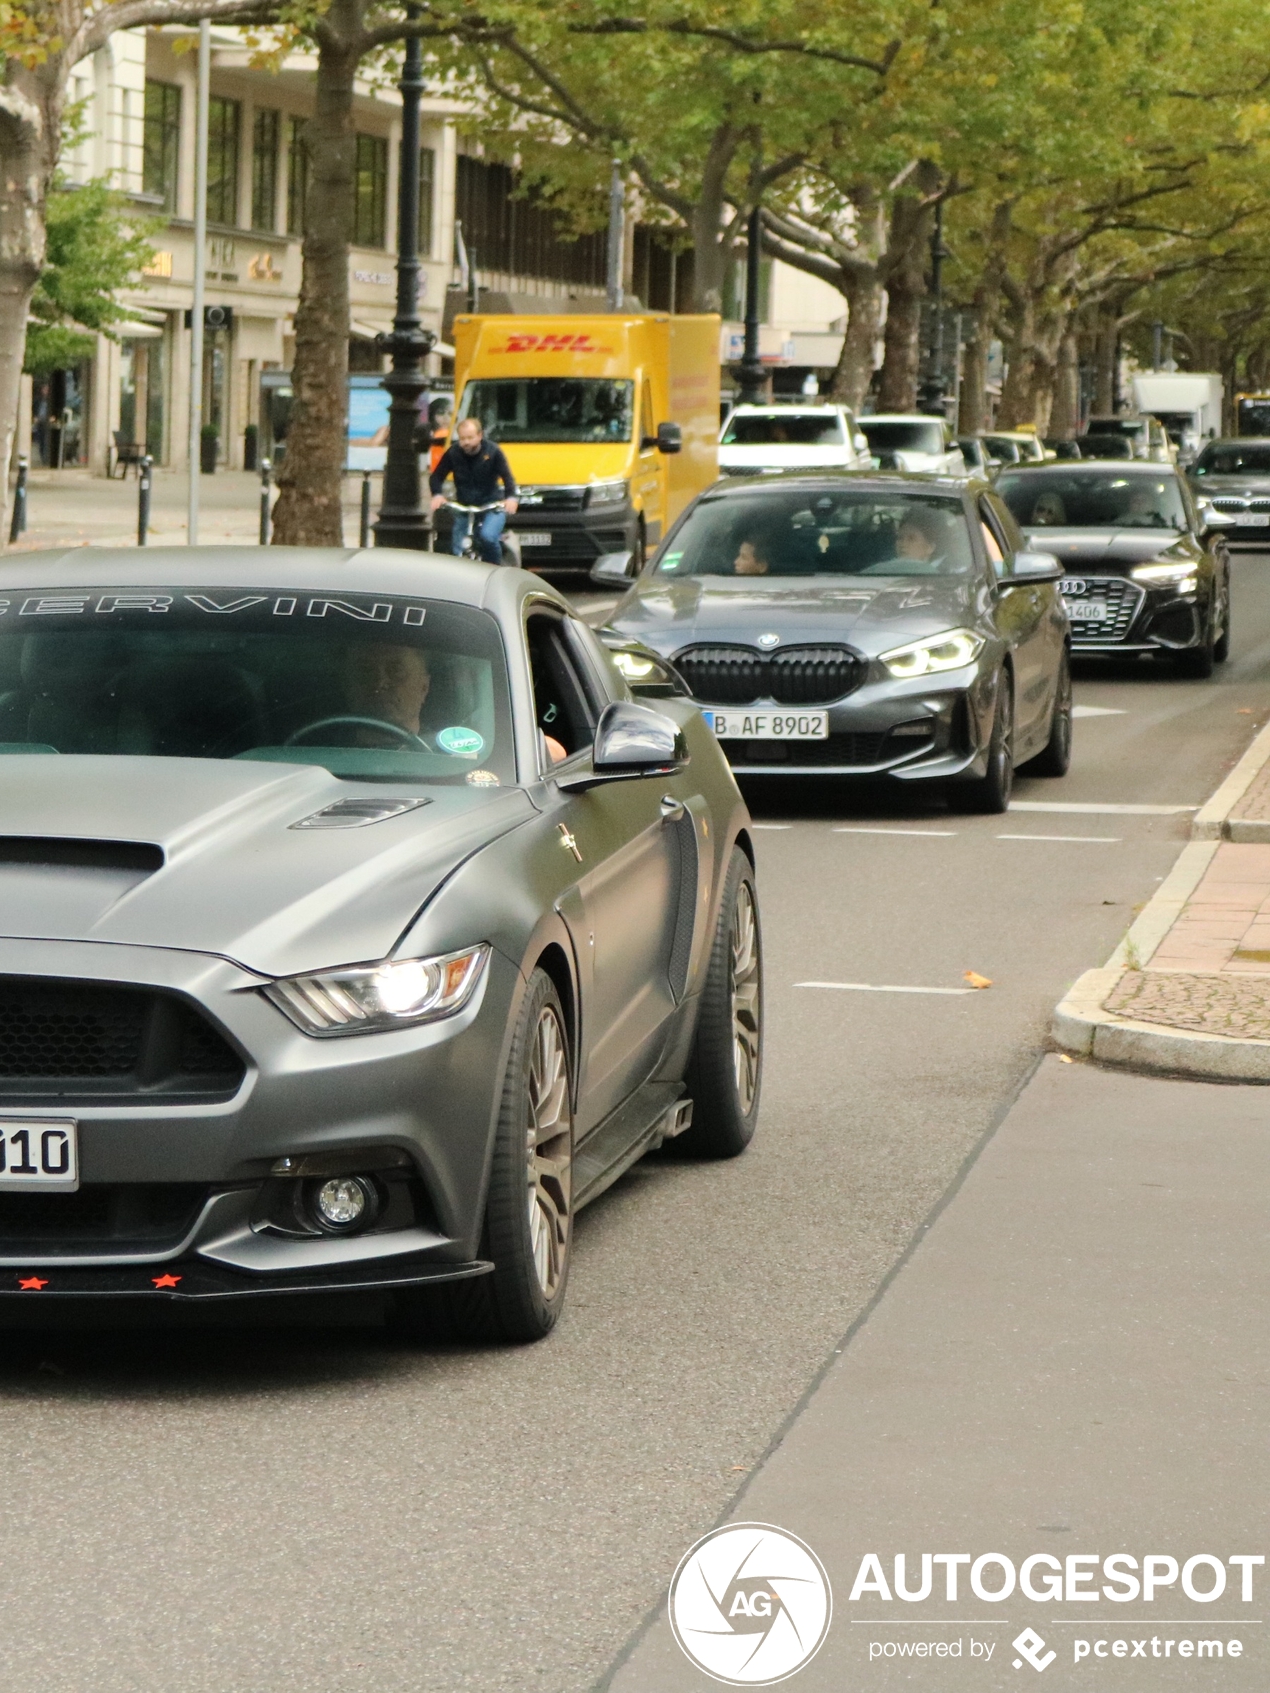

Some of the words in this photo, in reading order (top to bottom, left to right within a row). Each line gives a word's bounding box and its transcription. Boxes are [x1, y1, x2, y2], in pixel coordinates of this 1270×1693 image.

[505, 335, 596, 353] DHL
[1068, 605, 1101, 618] 1406
[715, 716, 727, 735] B
[742, 716, 767, 735] AF
[772, 716, 823, 735] 8902
